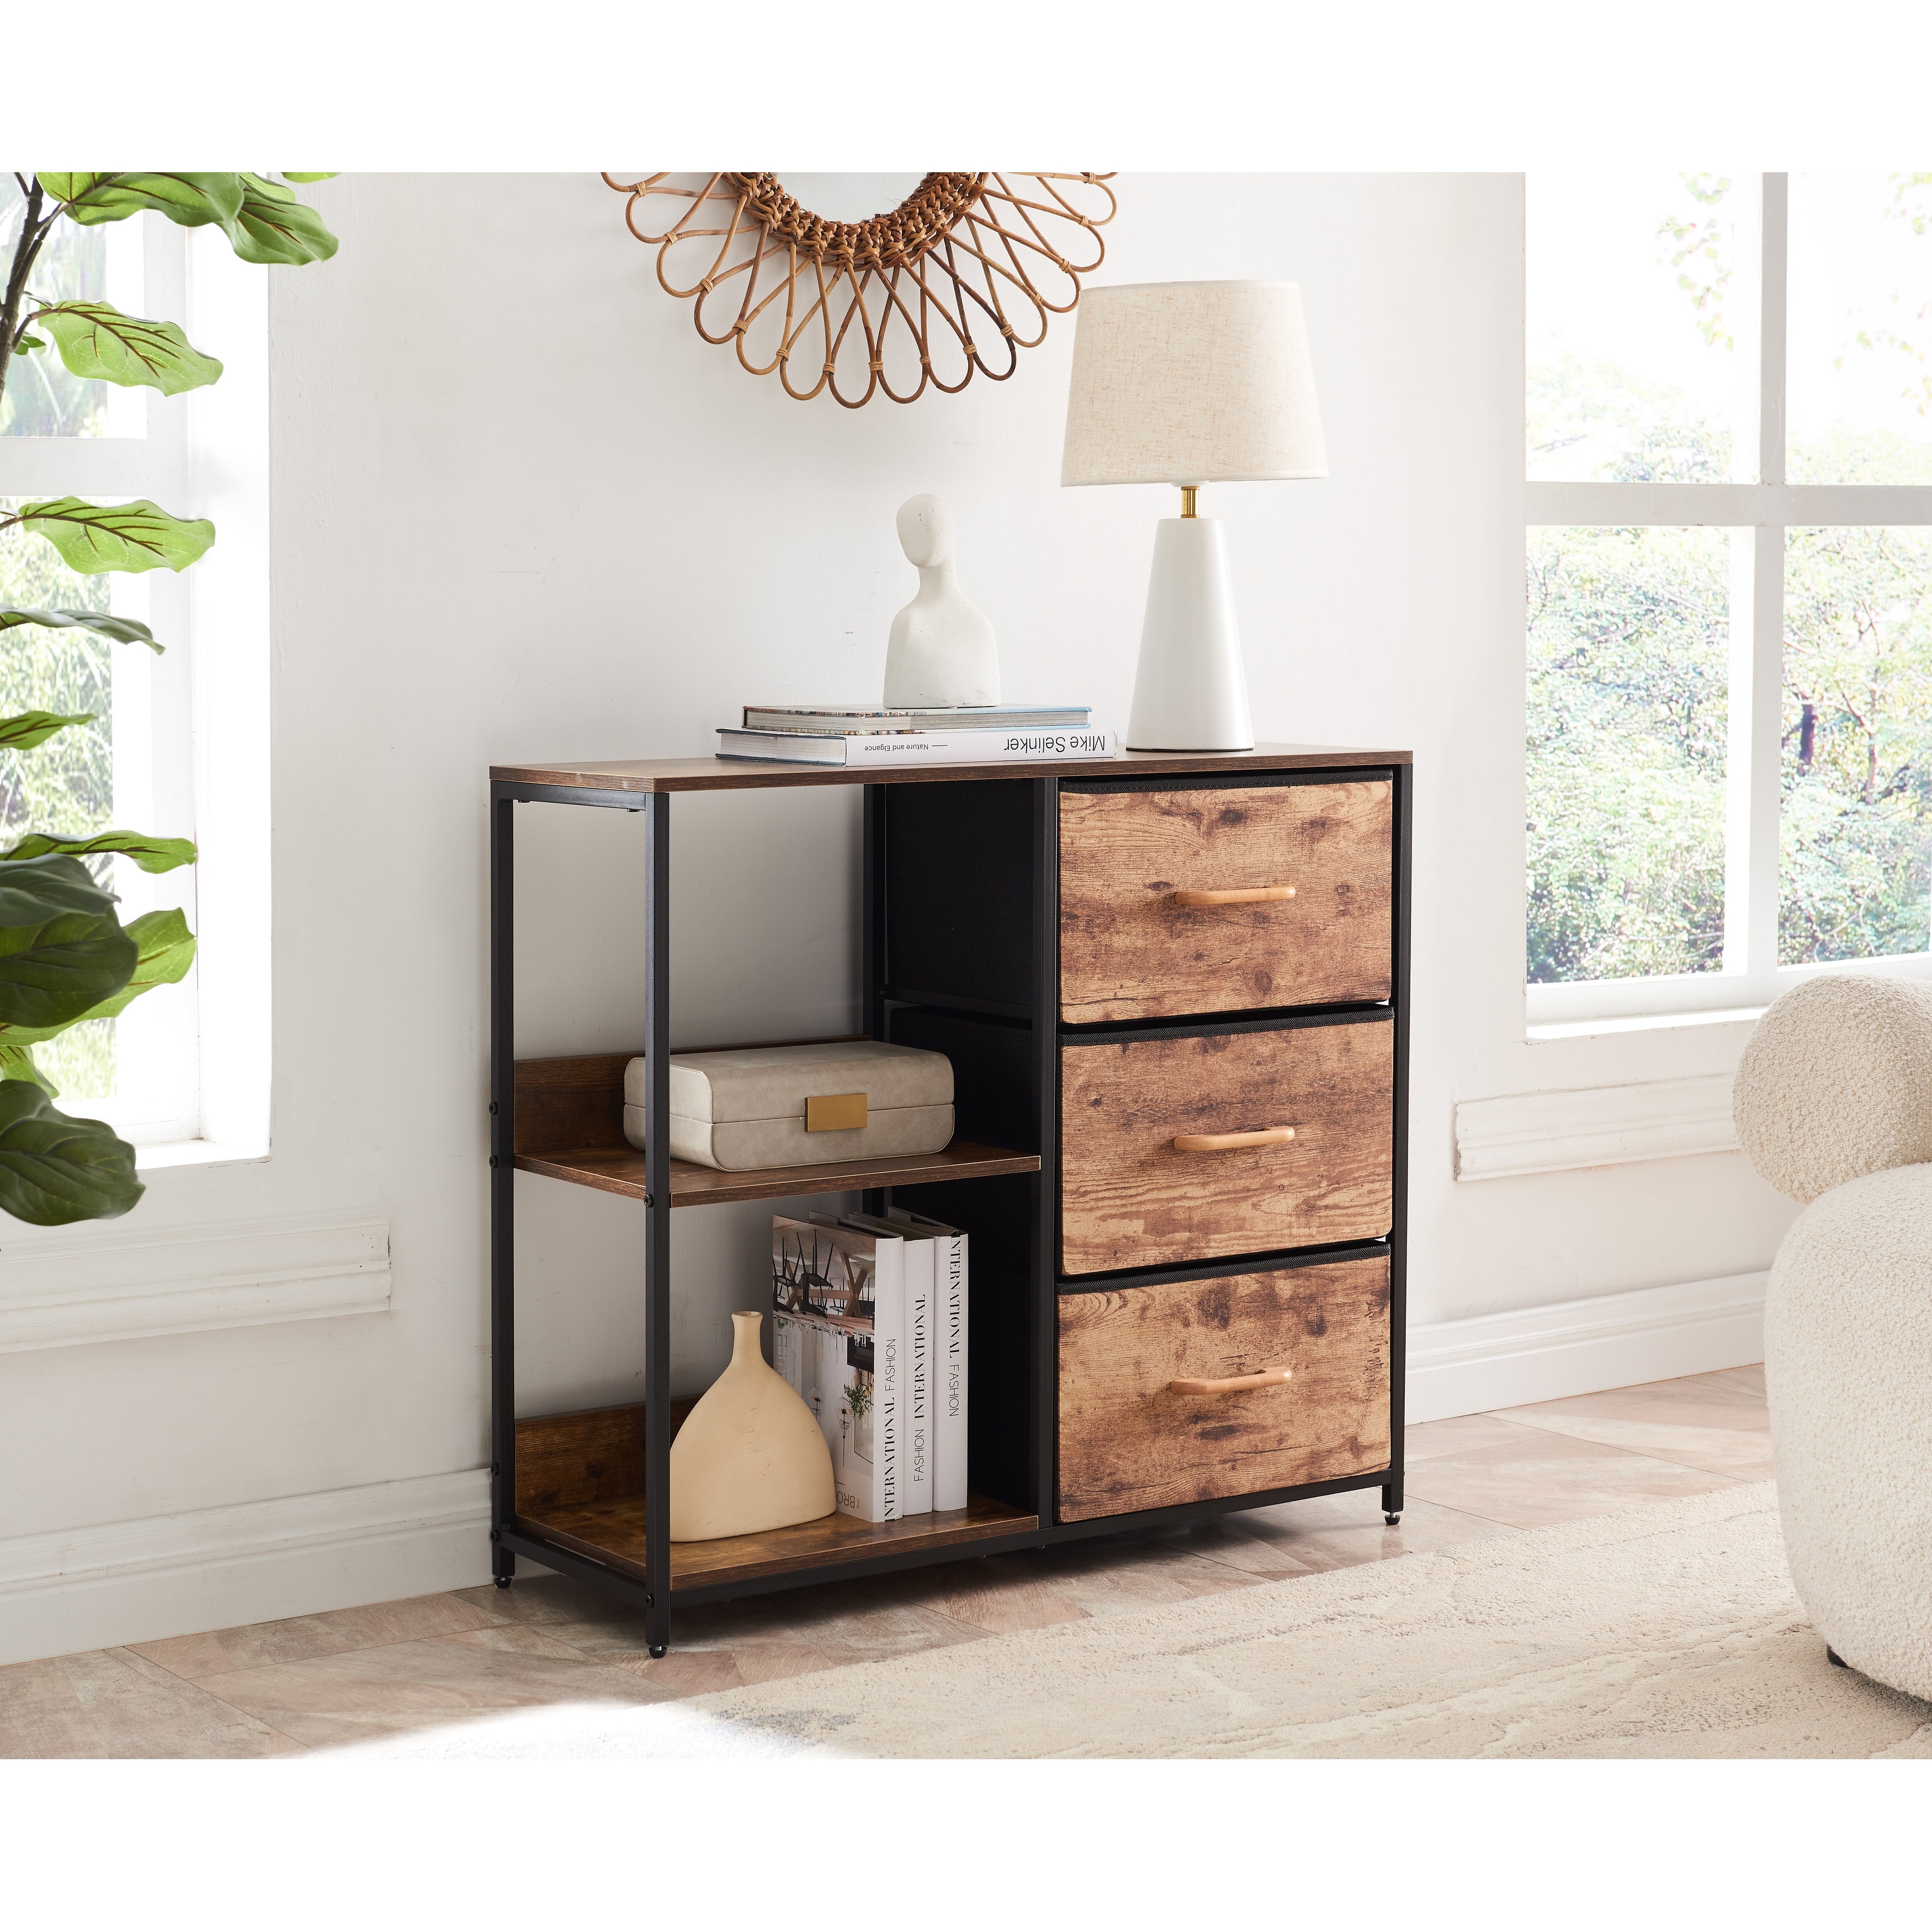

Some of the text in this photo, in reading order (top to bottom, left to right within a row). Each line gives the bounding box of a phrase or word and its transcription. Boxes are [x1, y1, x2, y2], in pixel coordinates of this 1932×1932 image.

[864, 744, 890, 752] Elgance
[1004, 735, 1105, 753] Mike Selinker
[885, 1339, 896, 1391] FASHION
[914, 1294, 926, 1482] FASHION INTERNATIONAL
[949, 1364, 959, 1416] FASHION
